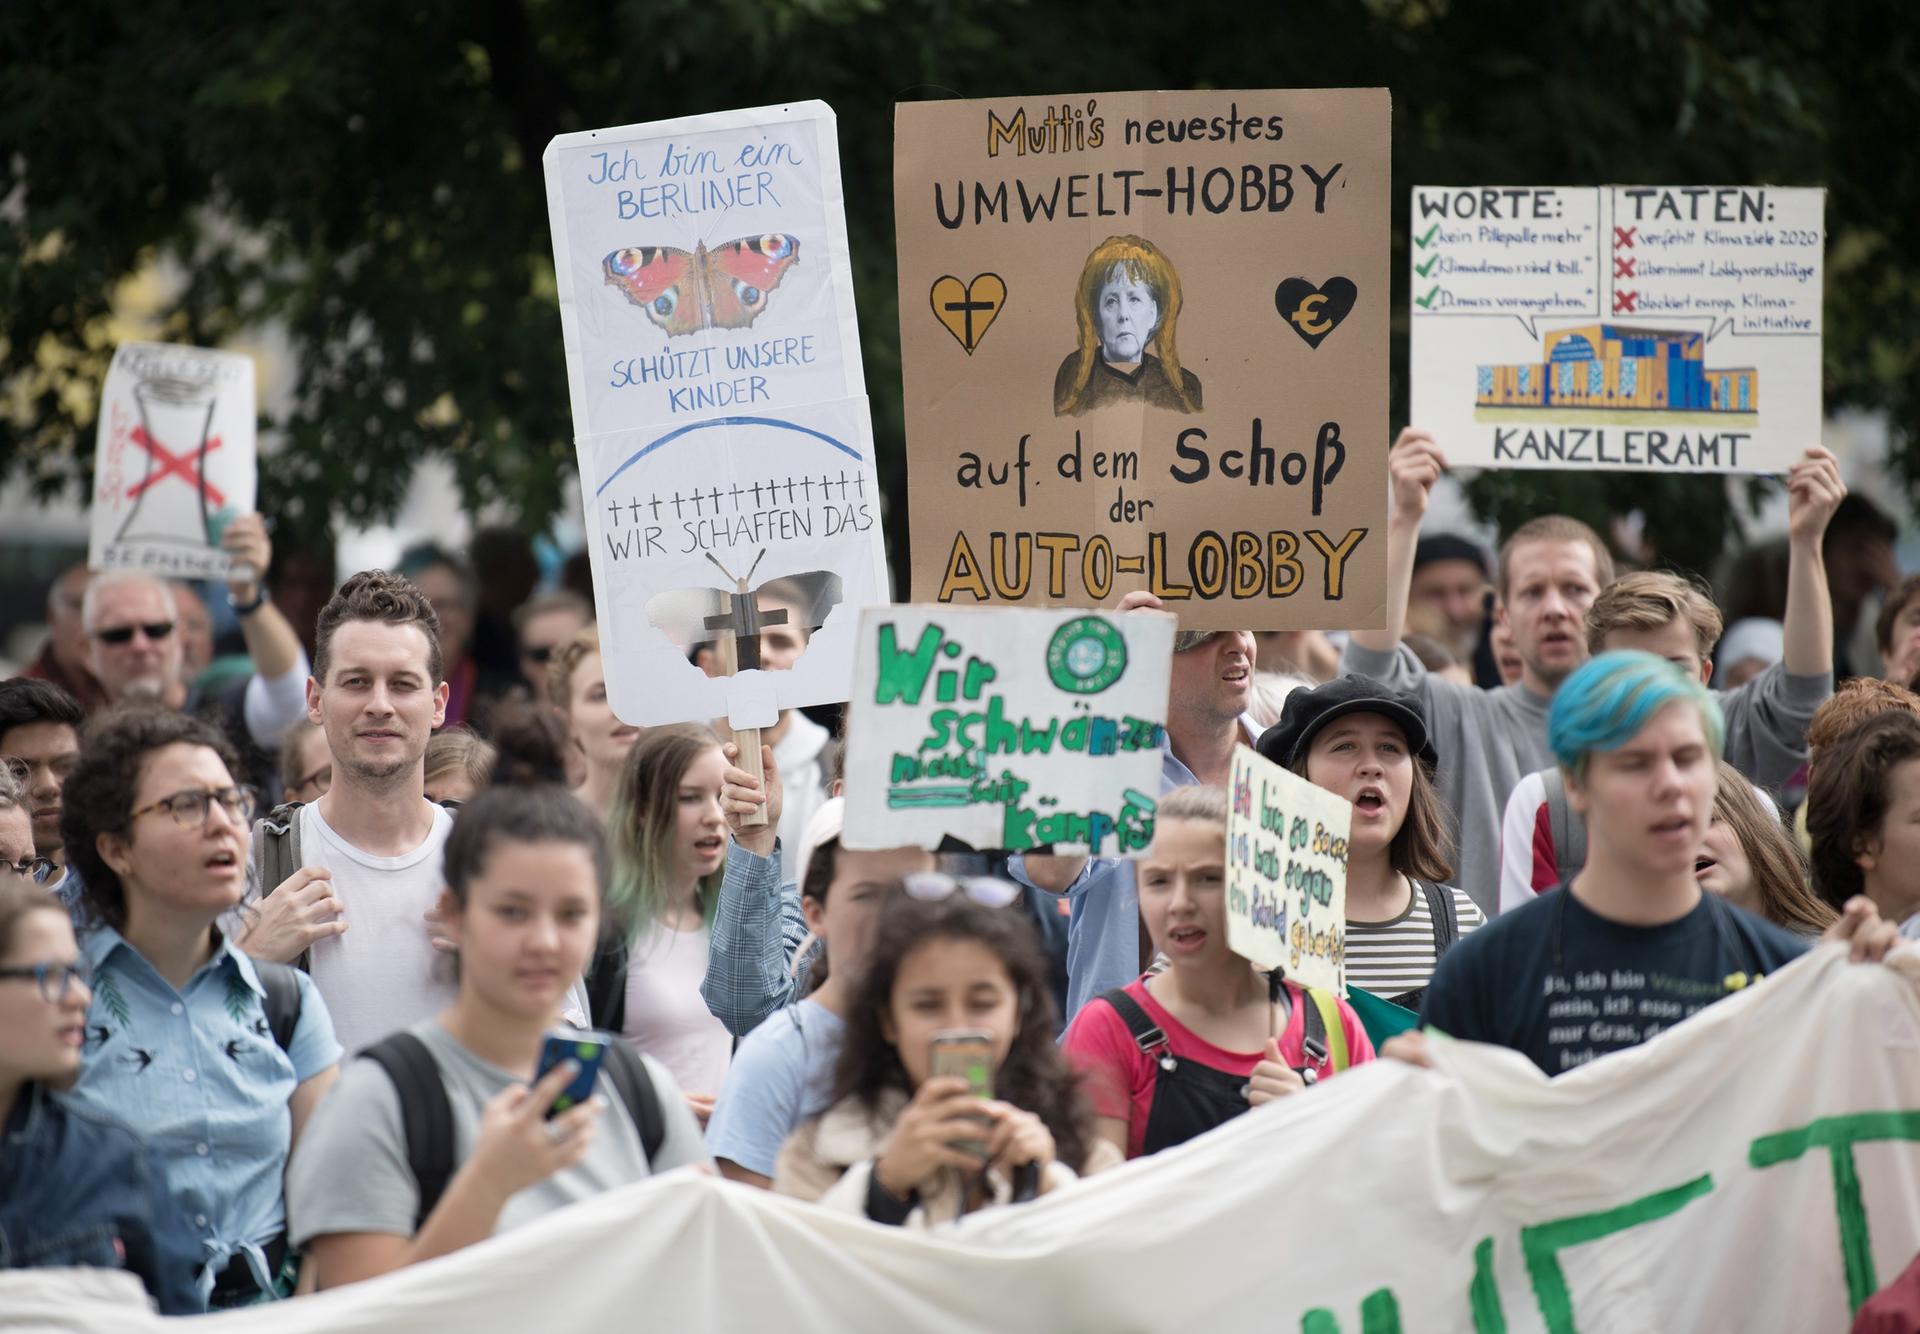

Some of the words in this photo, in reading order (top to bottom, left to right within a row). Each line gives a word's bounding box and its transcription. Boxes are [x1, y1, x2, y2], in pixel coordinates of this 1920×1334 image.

[987, 99, 1104, 157] Mutti's
[1125, 103, 1284, 145] neuestes
[588, 149, 646, 184] Ich
[659, 143, 724, 178] bin
[734, 135, 803, 168] ein
[617, 171, 781, 219] BERLINER
[934, 163, 1343, 229] UMWELT-HOBBY
[1418, 189, 1563, 219] WORTE:
[1625, 189, 1775, 223] TATEN:
[1638, 229, 1696, 251] verfehlt
[1779, 230, 1819, 247] 2020
[1743, 314, 1812, 330] initiative
[610, 346, 716, 387] SCHÜTZT
[726, 335, 816, 371] UNSERE
[668, 375, 770, 412] KINDER
[1057, 430, 1139, 482] dem
[1170, 417, 1346, 515] Schoß
[1493, 427, 1752, 467] KANZLERAMT
[1109, 486, 1154, 523] der
[606, 526, 668, 560] WIR
[681, 506, 812, 554] SCHAFFEN
[823, 503, 874, 536] DAS
[937, 527, 1369, 603] AUTO-LOBBY
[874, 621, 997, 705] Wir
[1260, 779, 1284, 841] bin
[1284, 859, 1333, 918] sogar
